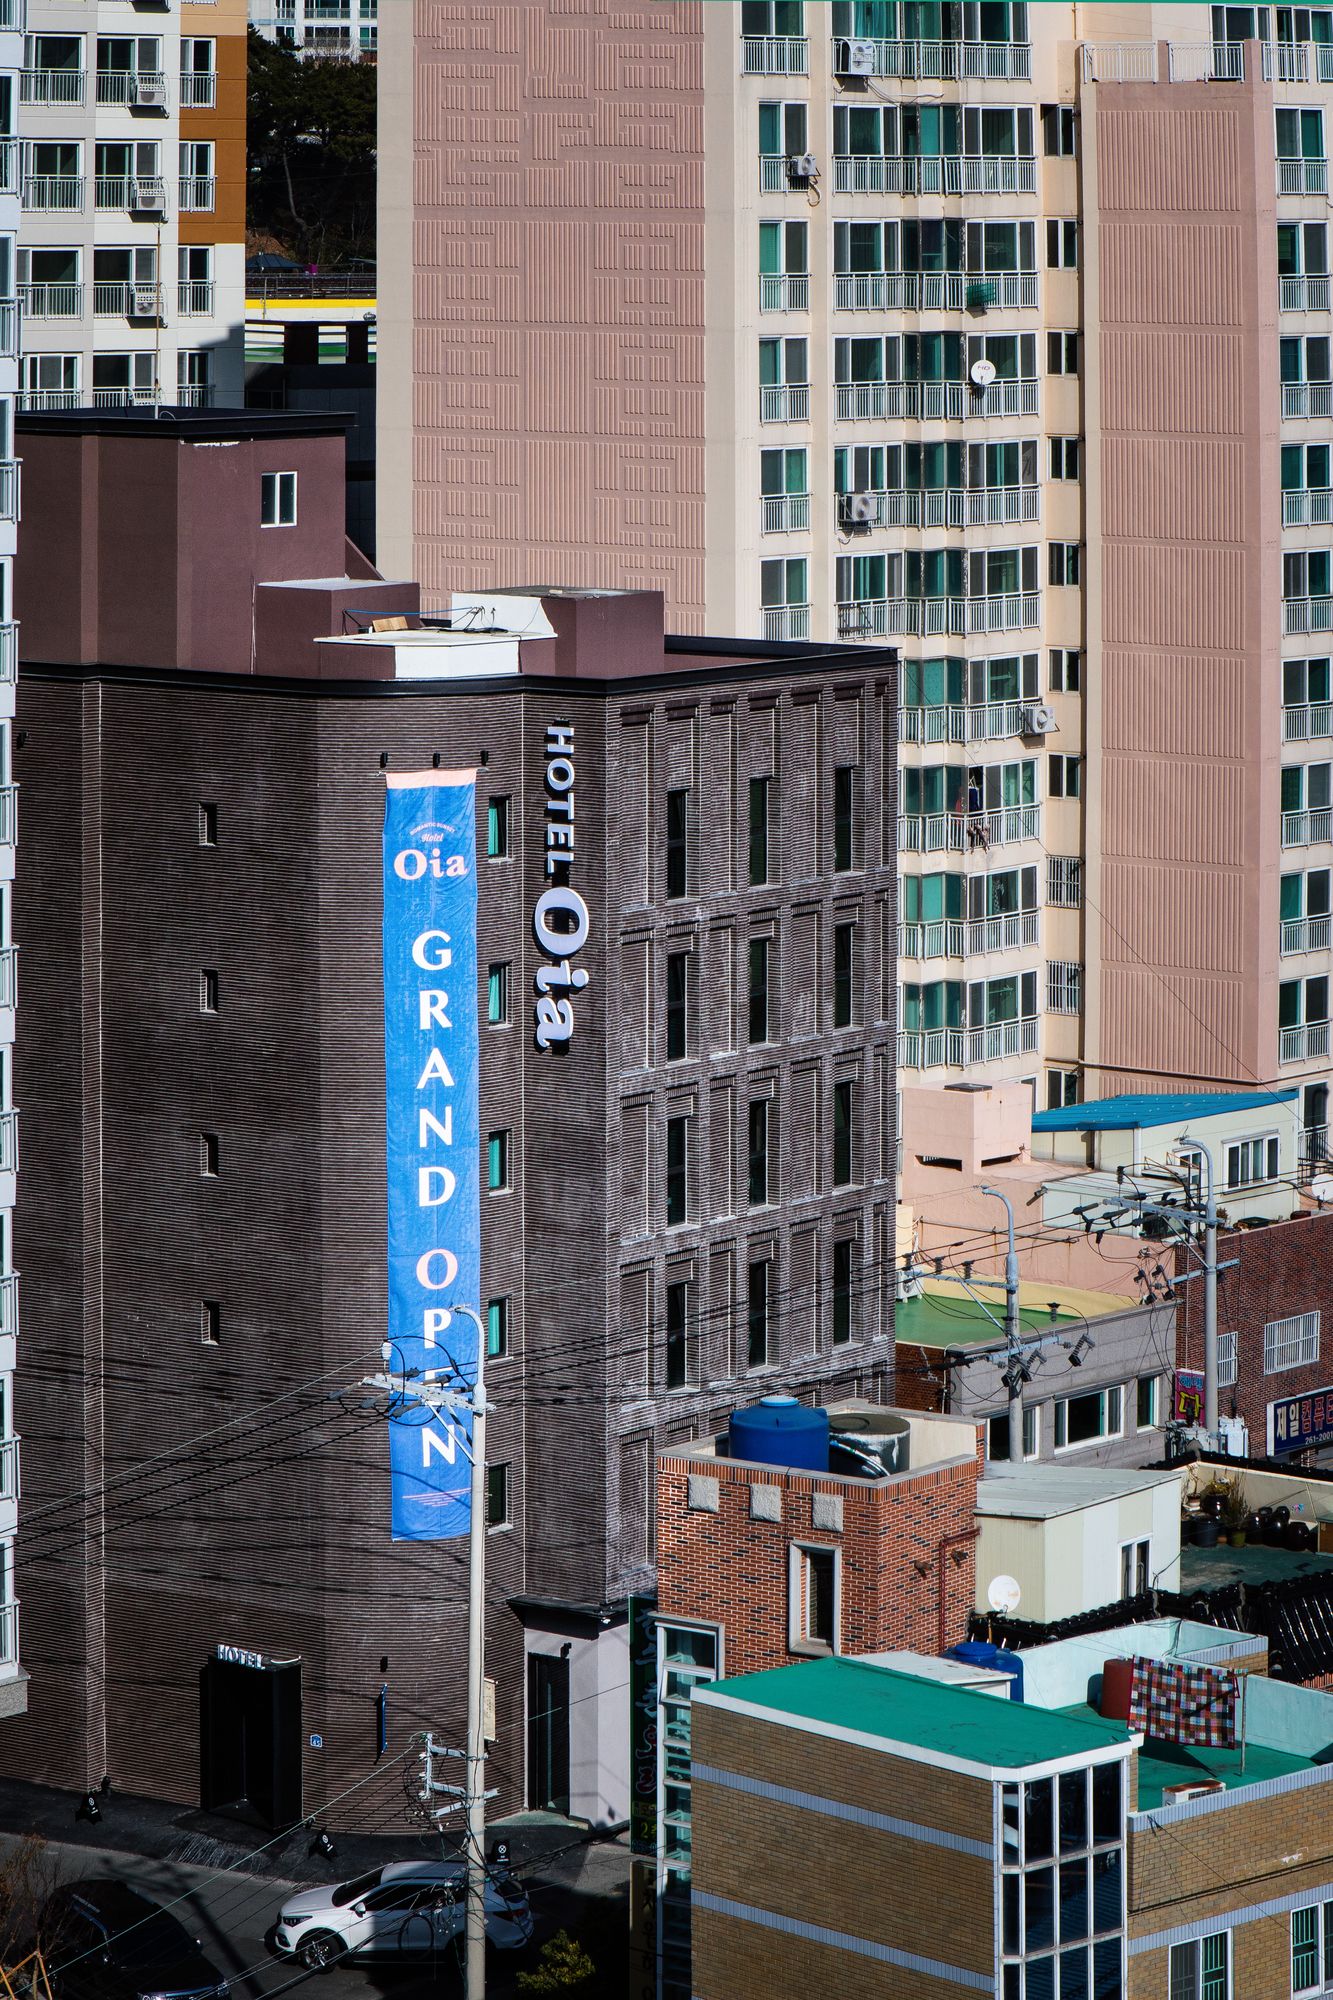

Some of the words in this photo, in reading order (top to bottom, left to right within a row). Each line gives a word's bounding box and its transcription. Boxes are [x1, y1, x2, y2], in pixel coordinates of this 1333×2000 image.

[421, 833, 444, 843] Hotel
[547, 726, 575, 874] HOTEL
[393, 848, 468, 880] Oia
[534, 886, 590, 1048] Oia
[411, 929, 456, 1207] GRAND
[217, 1644, 266, 1670] HOTEL
